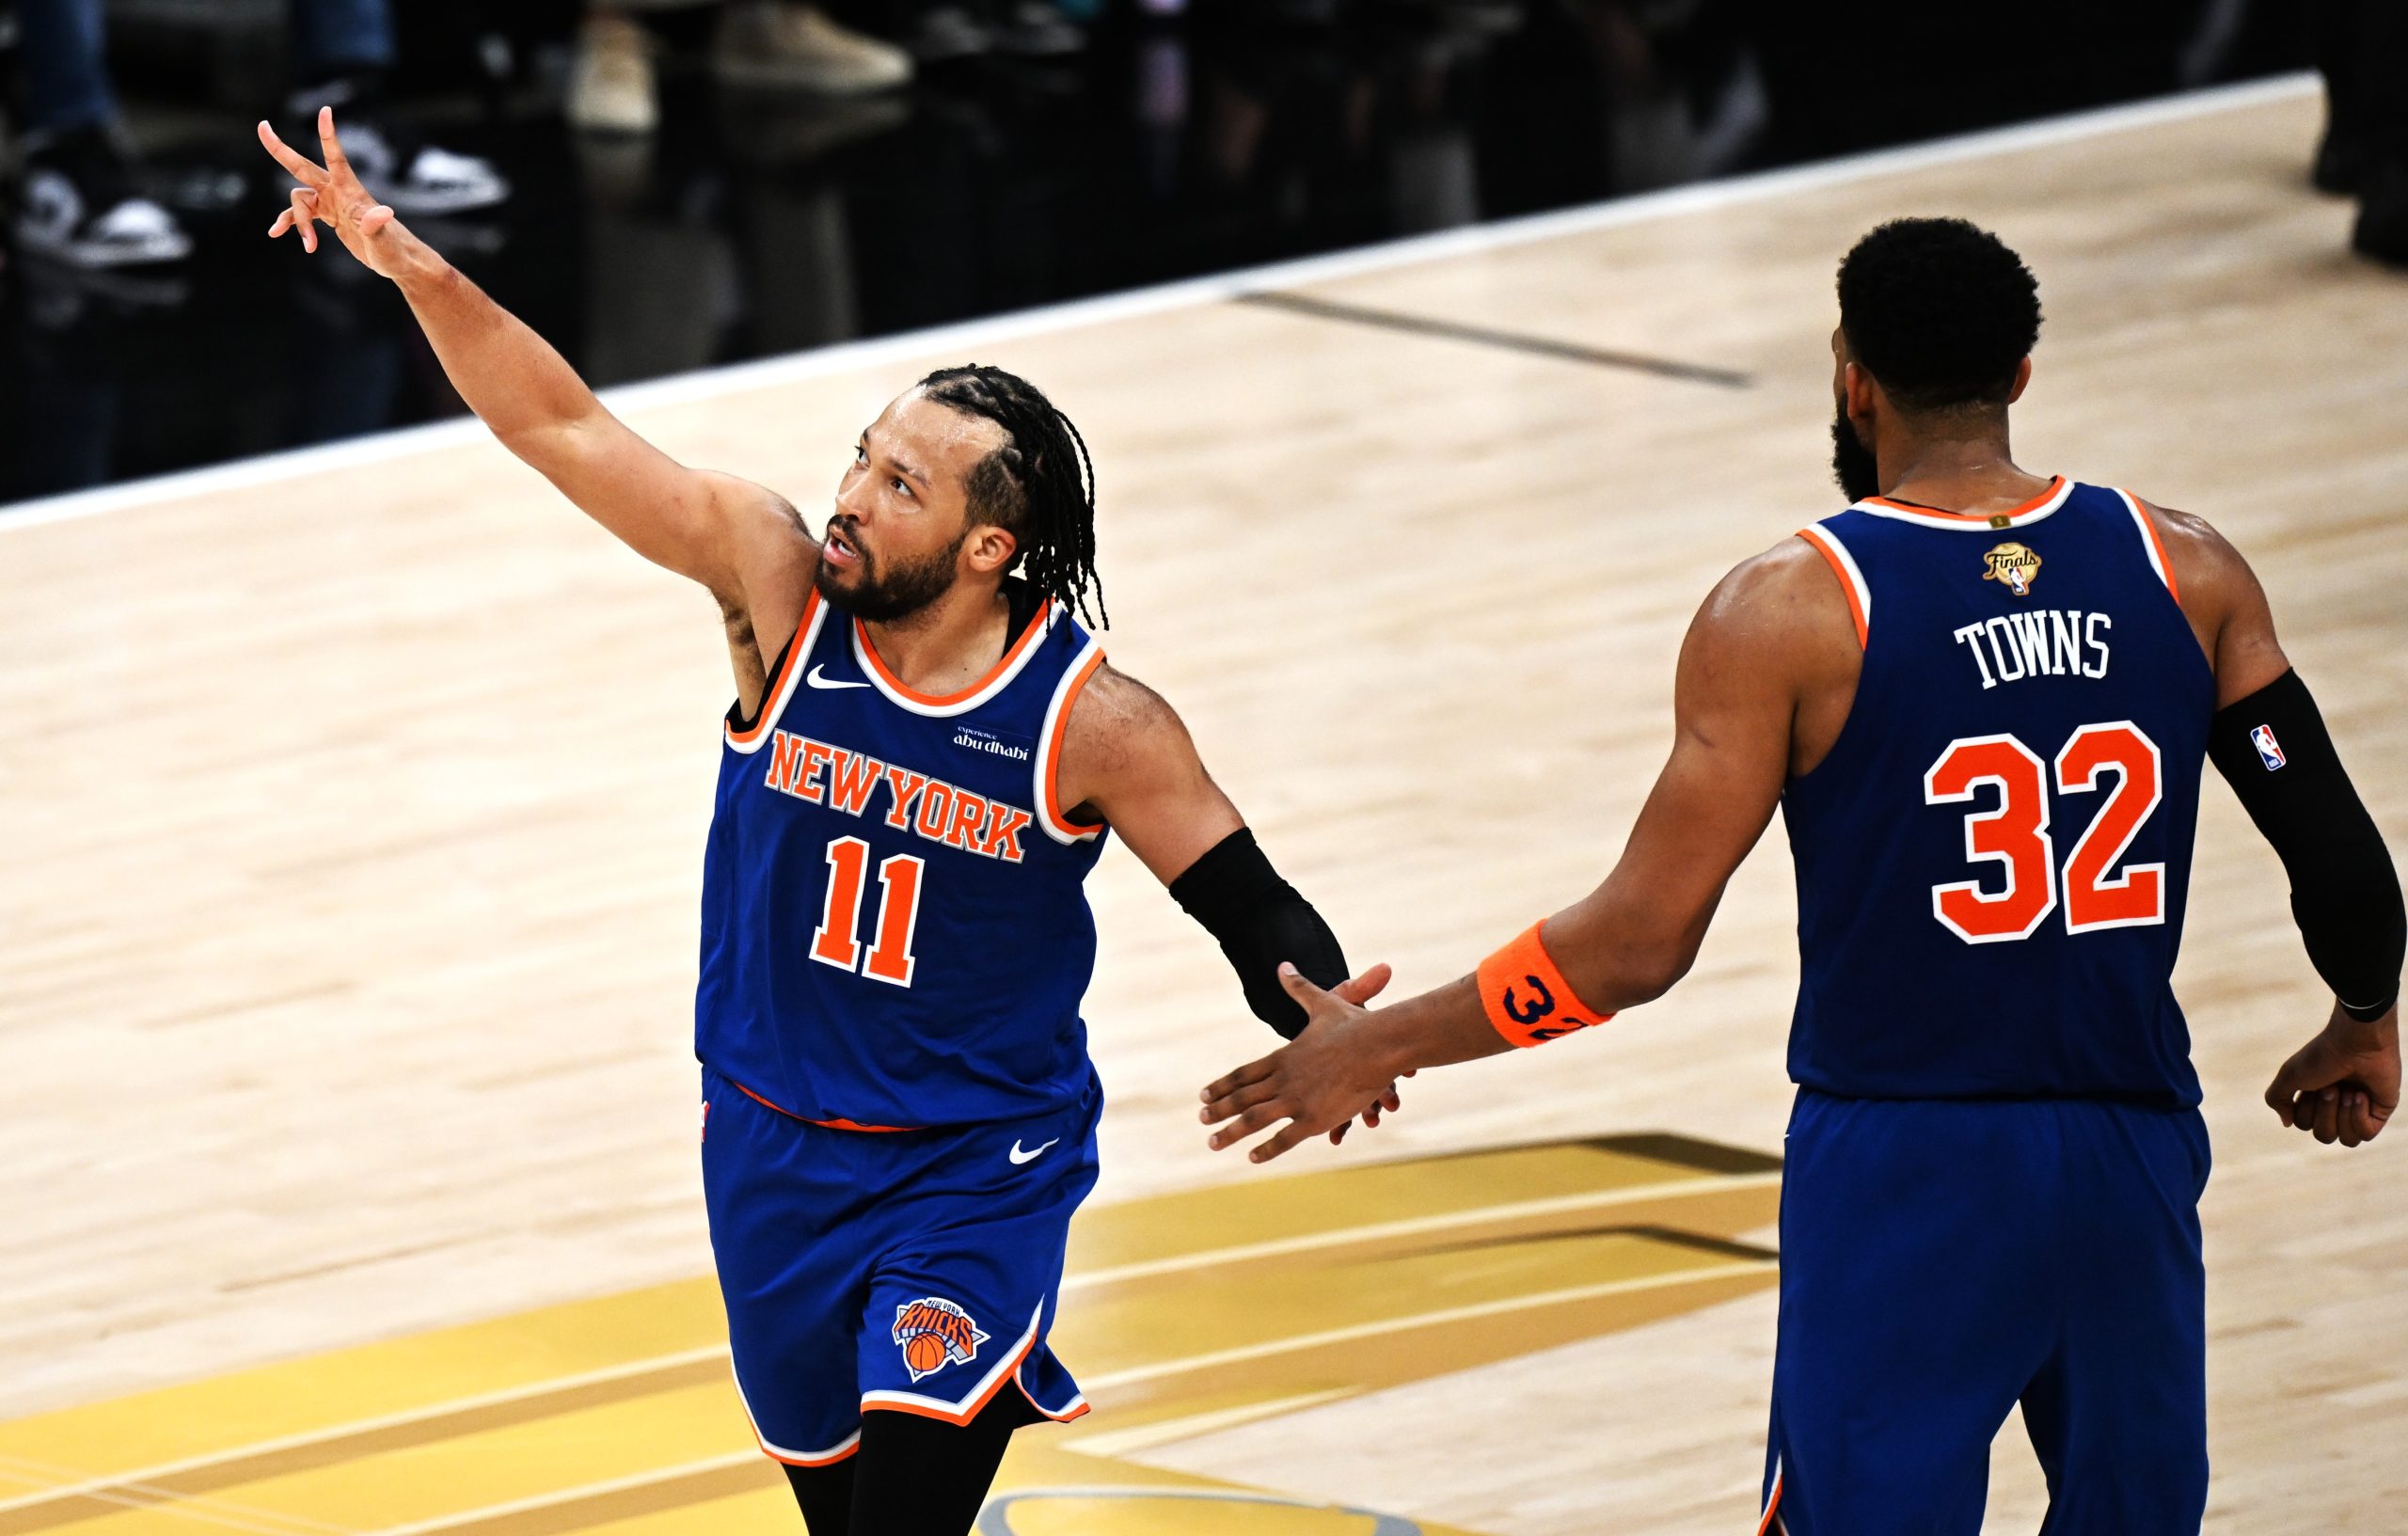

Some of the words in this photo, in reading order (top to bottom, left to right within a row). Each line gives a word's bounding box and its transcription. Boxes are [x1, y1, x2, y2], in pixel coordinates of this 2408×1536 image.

[1986, 550, 2038, 577] Finals
[1954, 610, 2112, 690] TOWNS
[953, 734, 983, 751] abu
[984, 741, 1030, 761] dhabi
[958, 725, 998, 740] experience
[764, 728, 884, 817] NEW
[883, 763, 1034, 864] YORK
[1924, 720, 2165, 944] 32
[809, 835, 925, 989] 11
[894, 1303, 974, 1356] KNICKS
[926, 1300, 942, 1308] NEW
